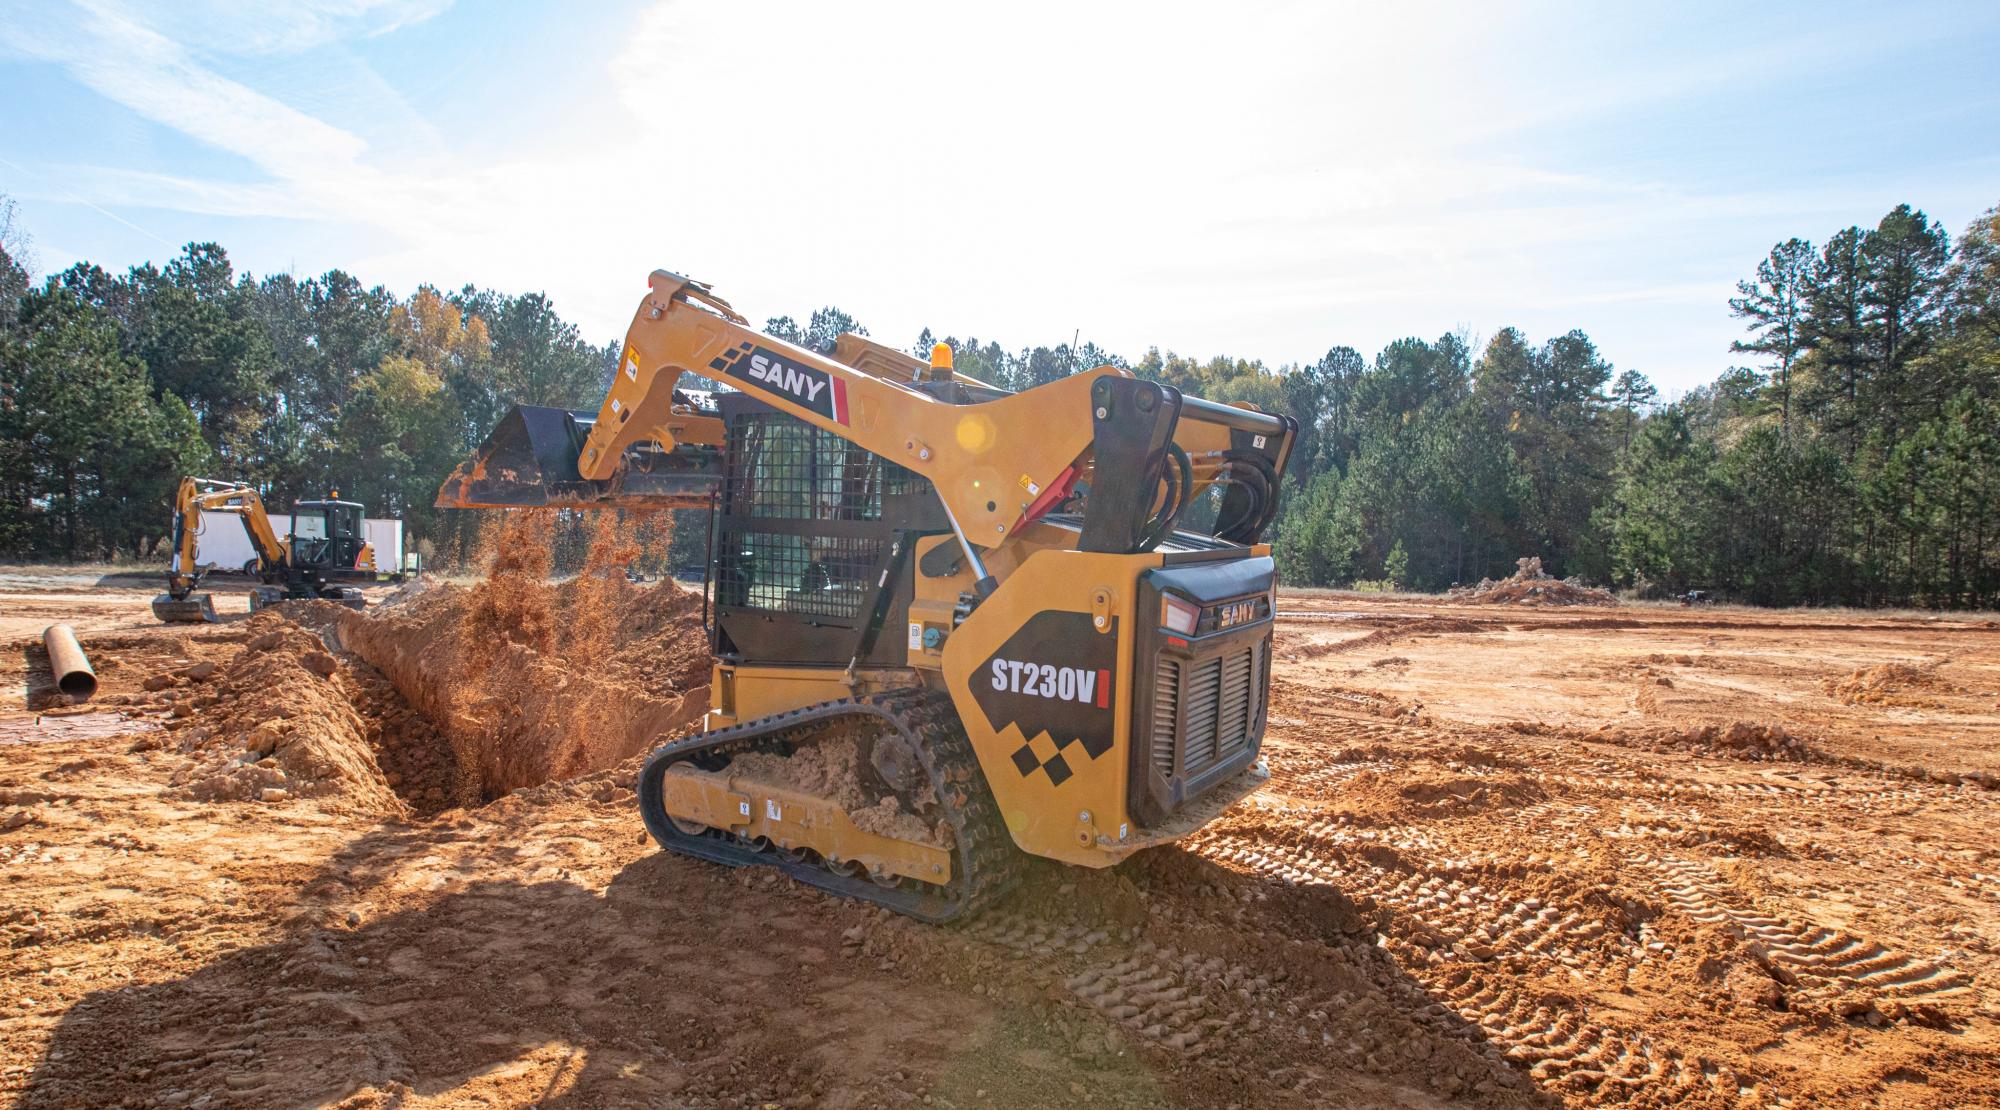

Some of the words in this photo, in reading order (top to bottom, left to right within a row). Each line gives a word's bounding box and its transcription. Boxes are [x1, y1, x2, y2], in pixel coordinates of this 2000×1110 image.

[748, 354, 826, 402] SANY
[1221, 601, 1256, 627] SANY
[991, 658, 1096, 703] ST230V
